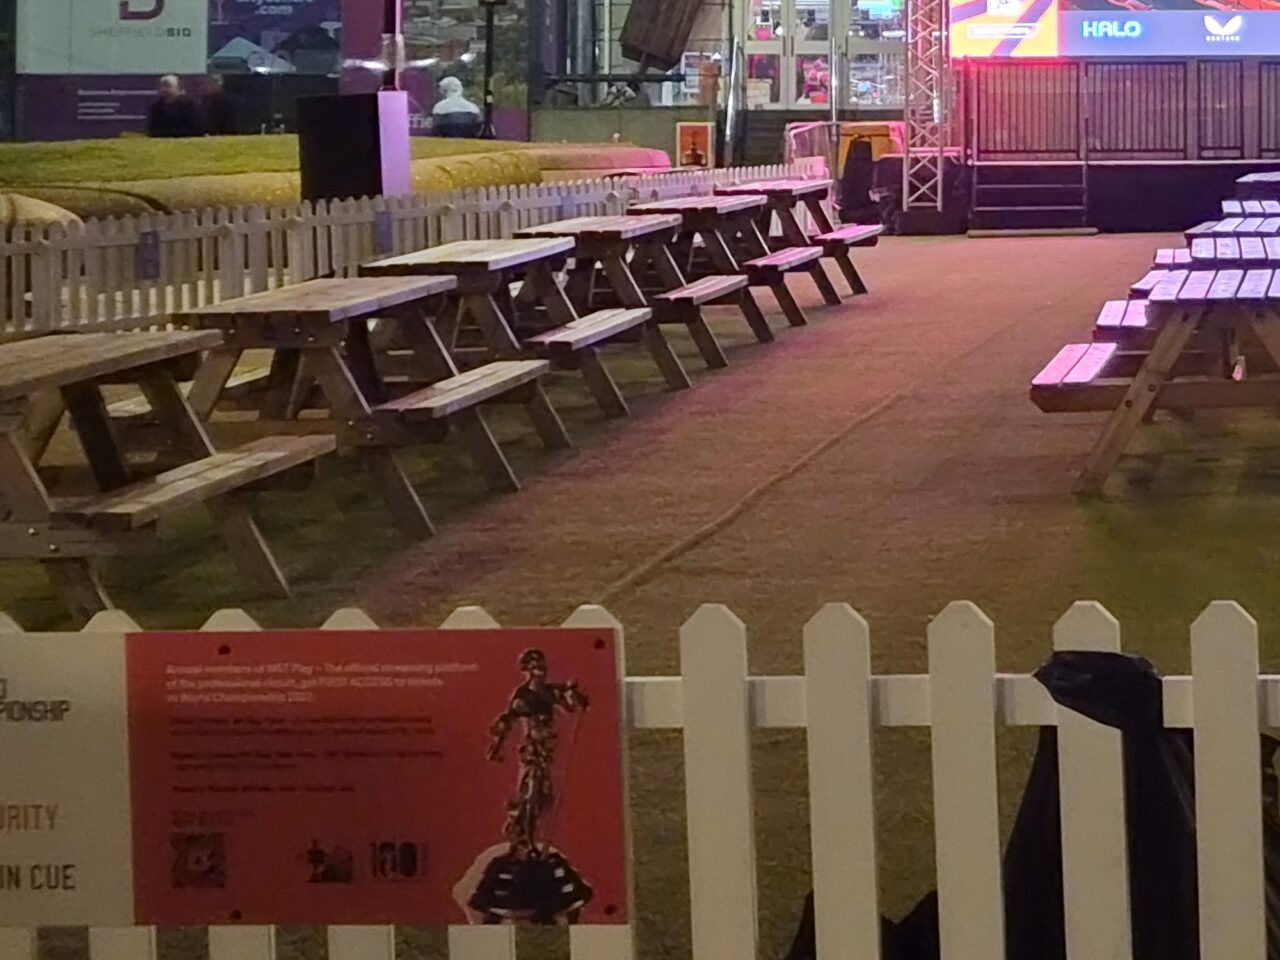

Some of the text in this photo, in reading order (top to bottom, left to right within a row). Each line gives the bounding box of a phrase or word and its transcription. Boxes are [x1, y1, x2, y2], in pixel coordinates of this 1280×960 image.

[255, 5, 293, 15] .com
[1082, 20, 1142, 37] HALO
[30, 864, 76, 890] CUE
